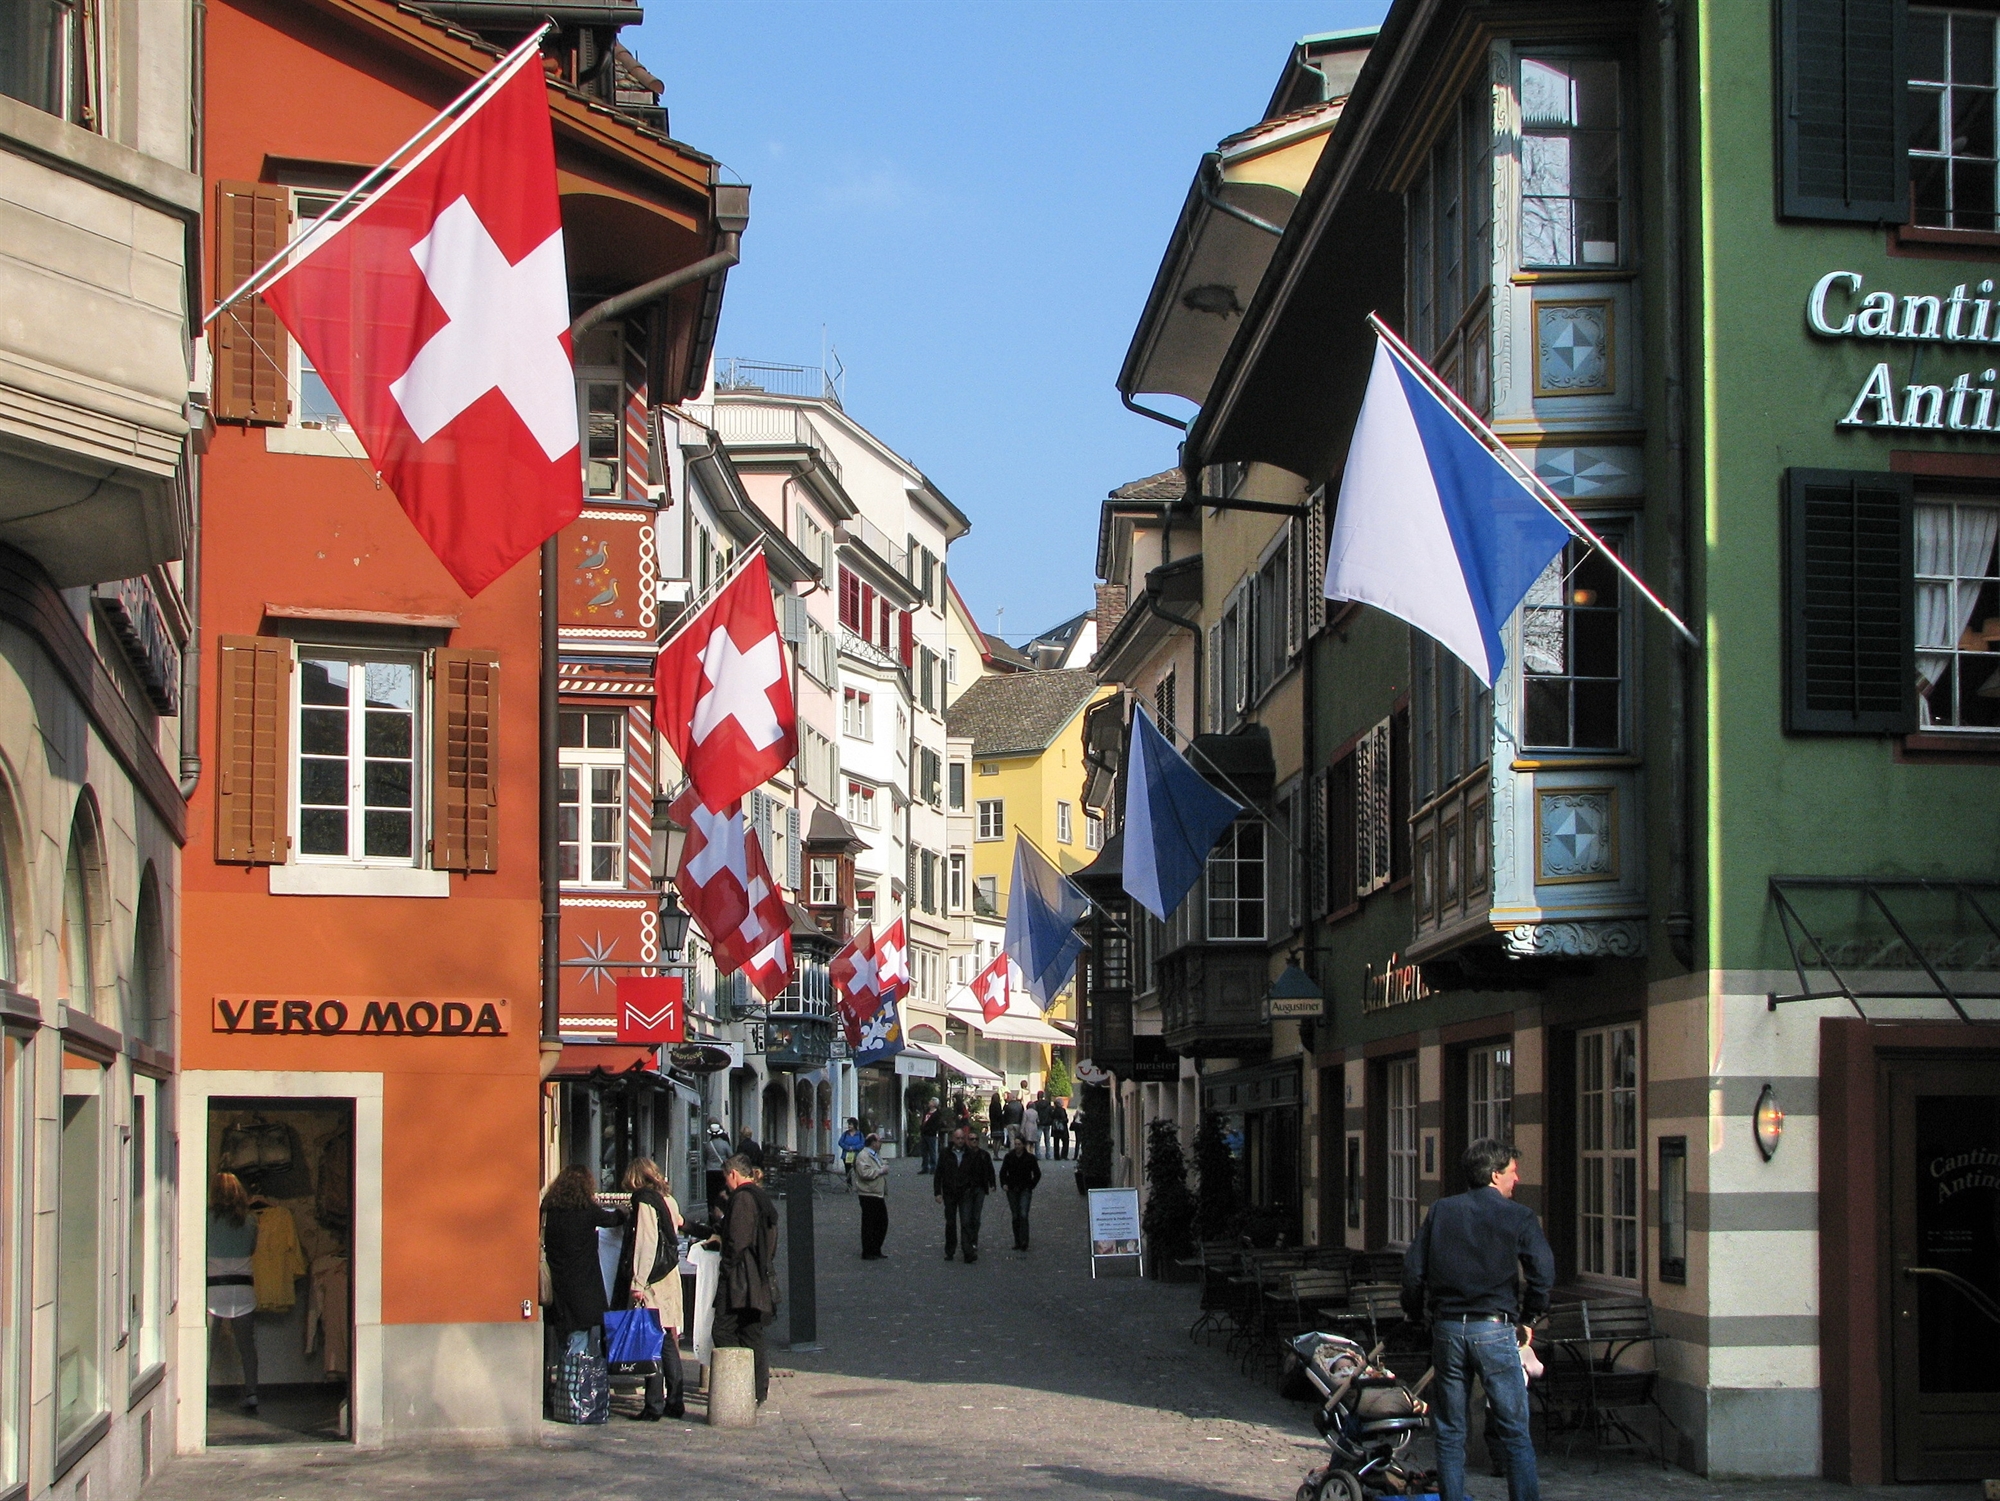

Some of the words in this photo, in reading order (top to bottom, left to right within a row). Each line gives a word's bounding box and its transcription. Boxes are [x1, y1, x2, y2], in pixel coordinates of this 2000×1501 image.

[1807, 271, 2000, 343] Canti
[1838, 363, 2000, 431] Anti
[218, 1000, 348, 1036] VERO
[359, 1000, 502, 1037] MODA
[1272, 1002, 1321, 1013] Augustiner
[1136, 1062, 1177, 1070] meister
[1930, 1147, 2000, 1178] Cantin
